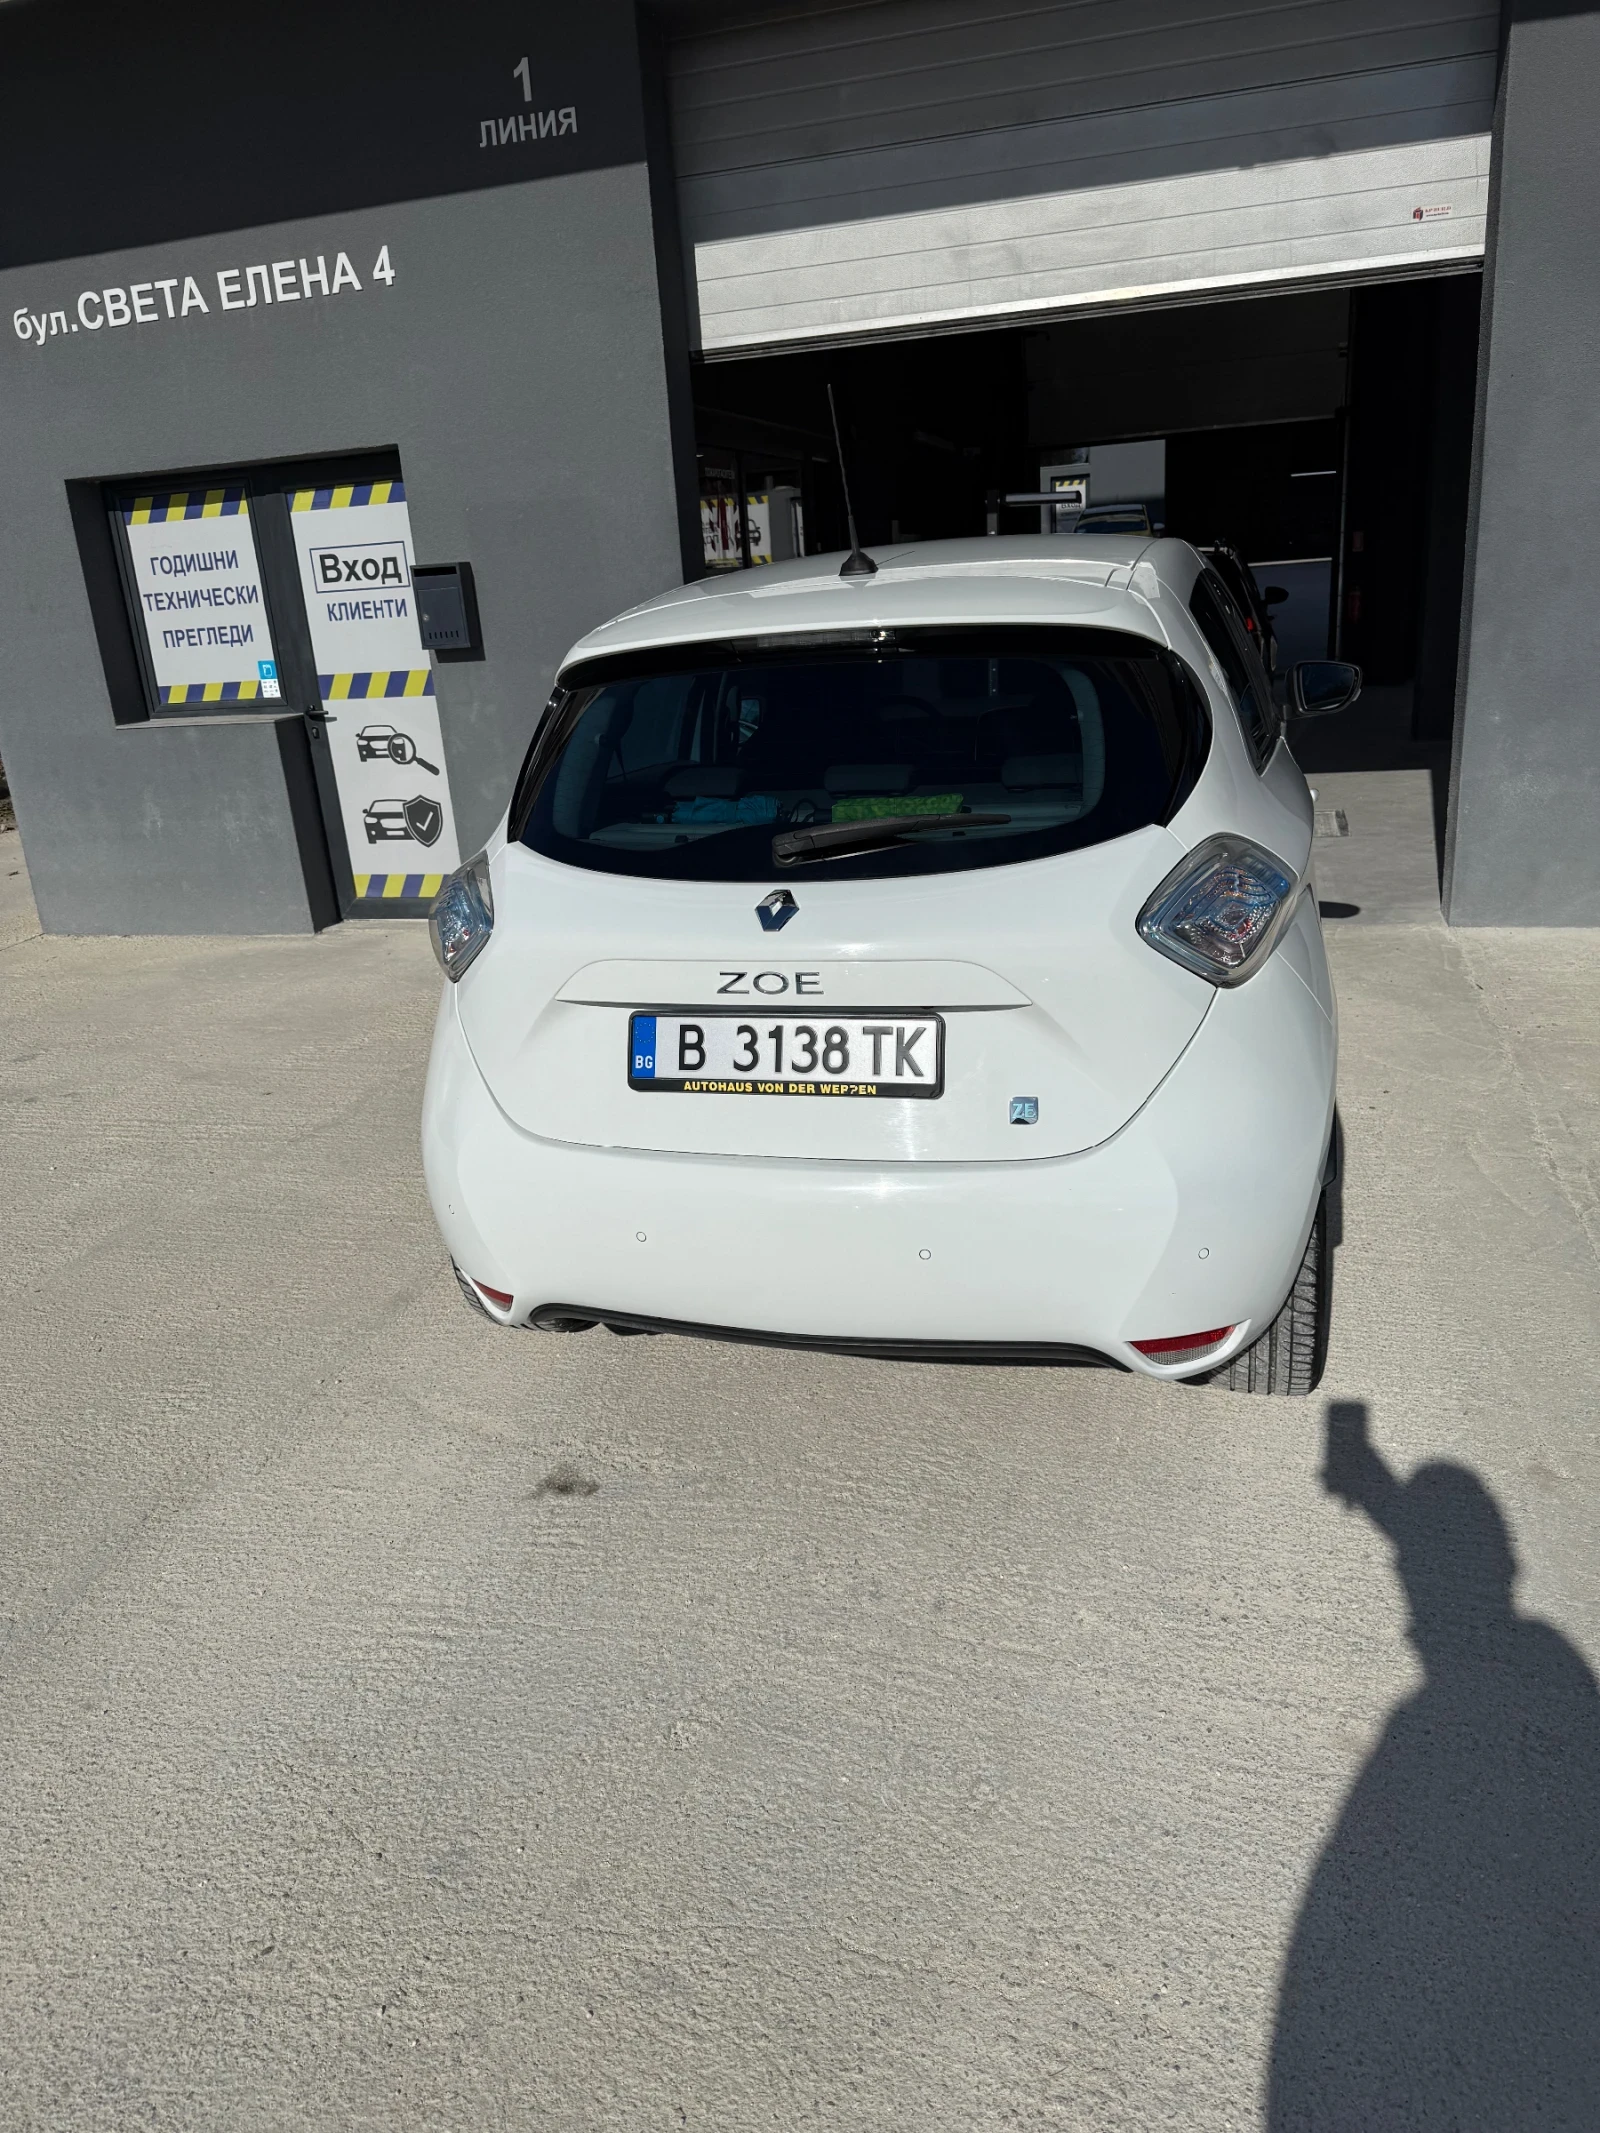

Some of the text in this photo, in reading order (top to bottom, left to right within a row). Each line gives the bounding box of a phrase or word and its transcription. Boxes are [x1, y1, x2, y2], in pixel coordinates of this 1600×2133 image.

[513, 57, 533, 102] 1
[479, 106, 579, 148] ЛИНИЯ
[216, 251, 363, 311] ЕЛЕНА
[372, 245, 396, 286] 4
[150, 550, 239, 577] ГОДИШНИ
[318, 554, 403, 586] Вход
[143, 585, 260, 612] ТЕХНИЧЕСКИ
[326, 599, 408, 622] КЛИЕНТИ
[162, 624, 255, 649] ПРЕГЛЕДИ
[716, 970, 825, 995] ZOE
[635, 1055, 653, 1069] BG
[678, 1024, 927, 1077] B 3138 TK
[683, 1080, 752, 1092] AUTOHAUS
[757, 1082, 784, 1093] VON
[788, 1083, 816, 1094] DER
